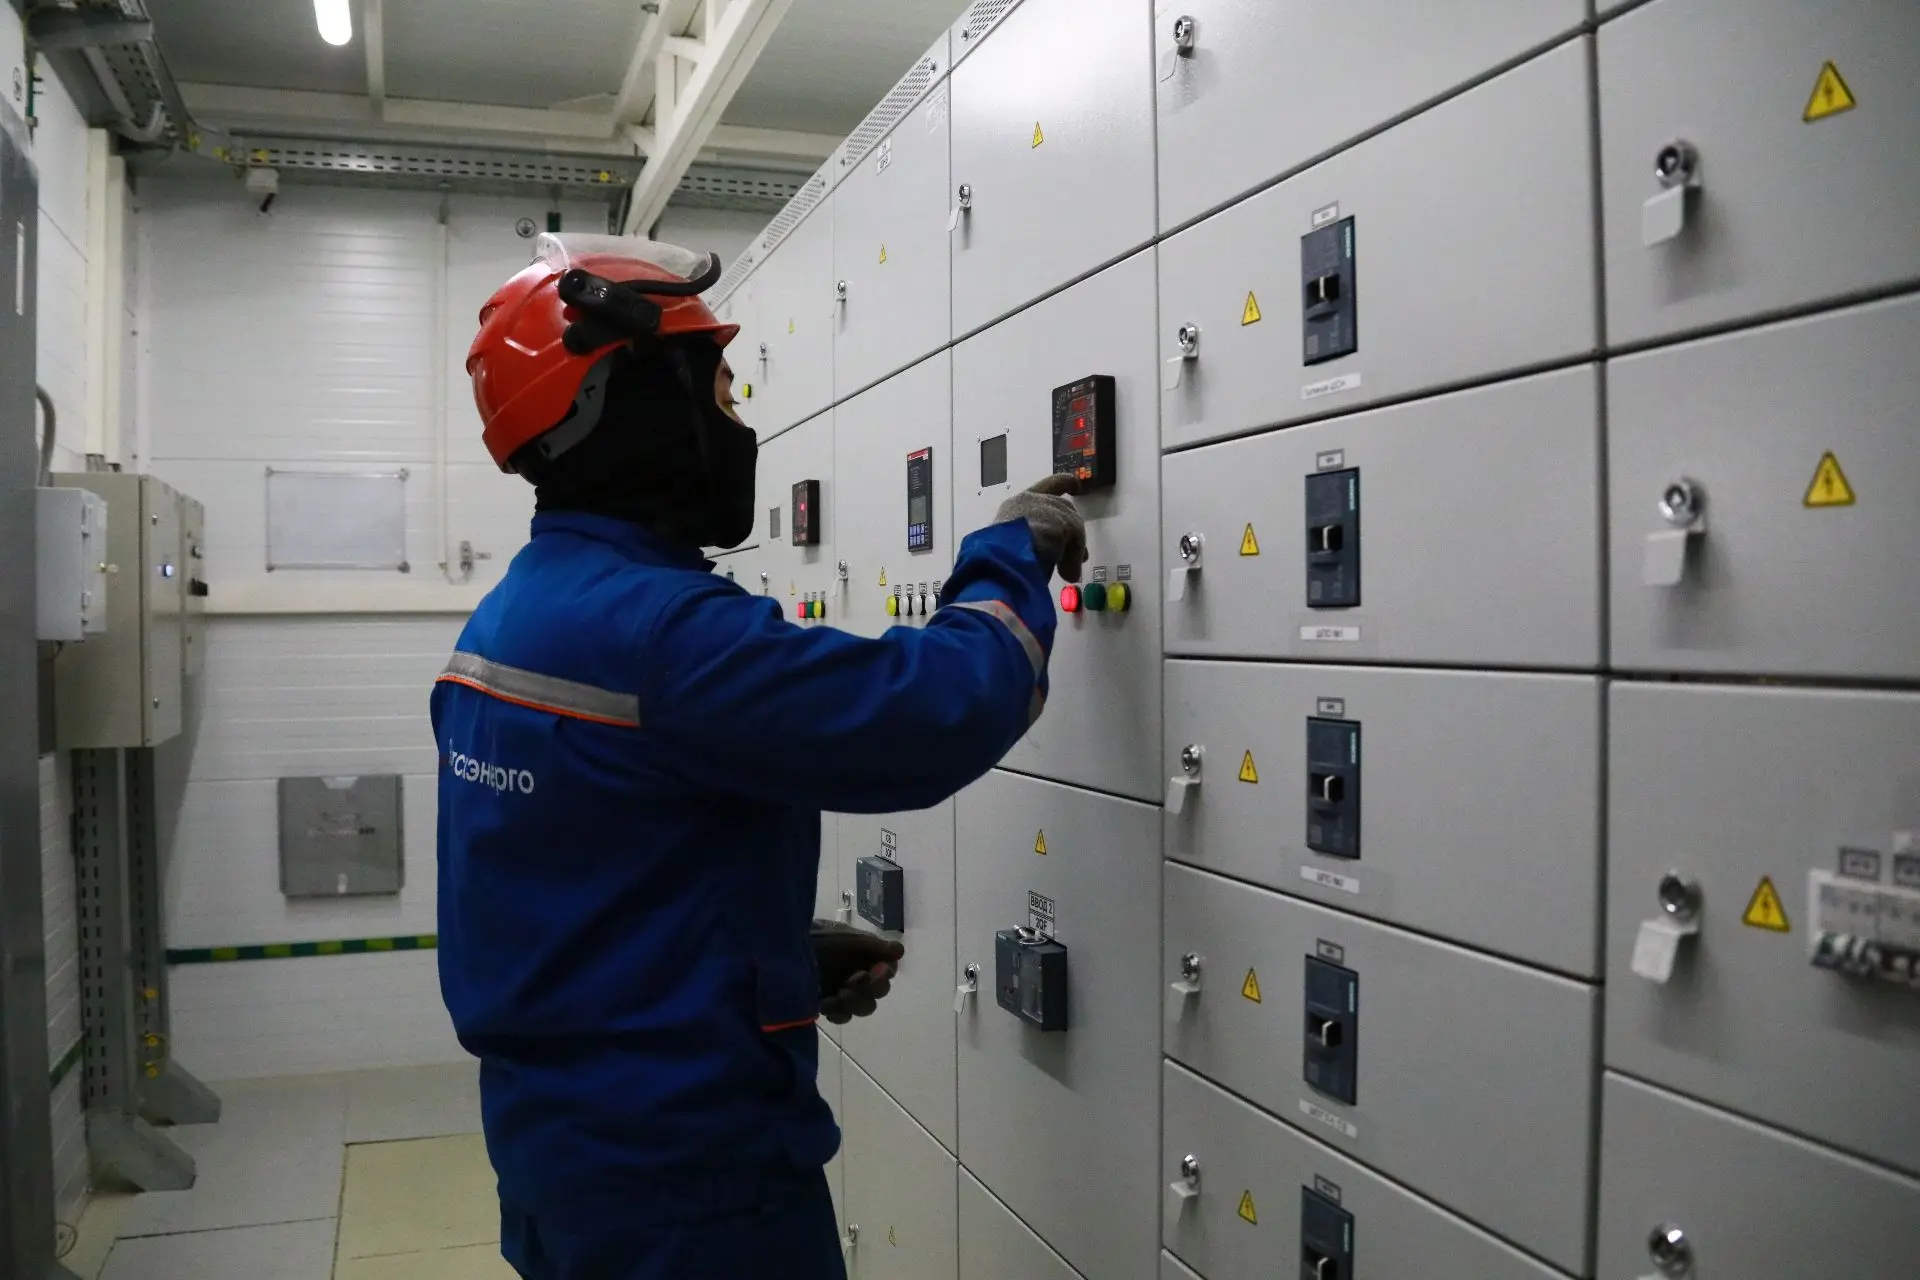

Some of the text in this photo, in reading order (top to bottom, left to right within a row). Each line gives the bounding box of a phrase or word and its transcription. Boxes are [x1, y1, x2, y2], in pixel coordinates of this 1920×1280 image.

[1030, 895, 1053, 914] ВВОД 2
[1035, 917, 1047, 931] 2QF
